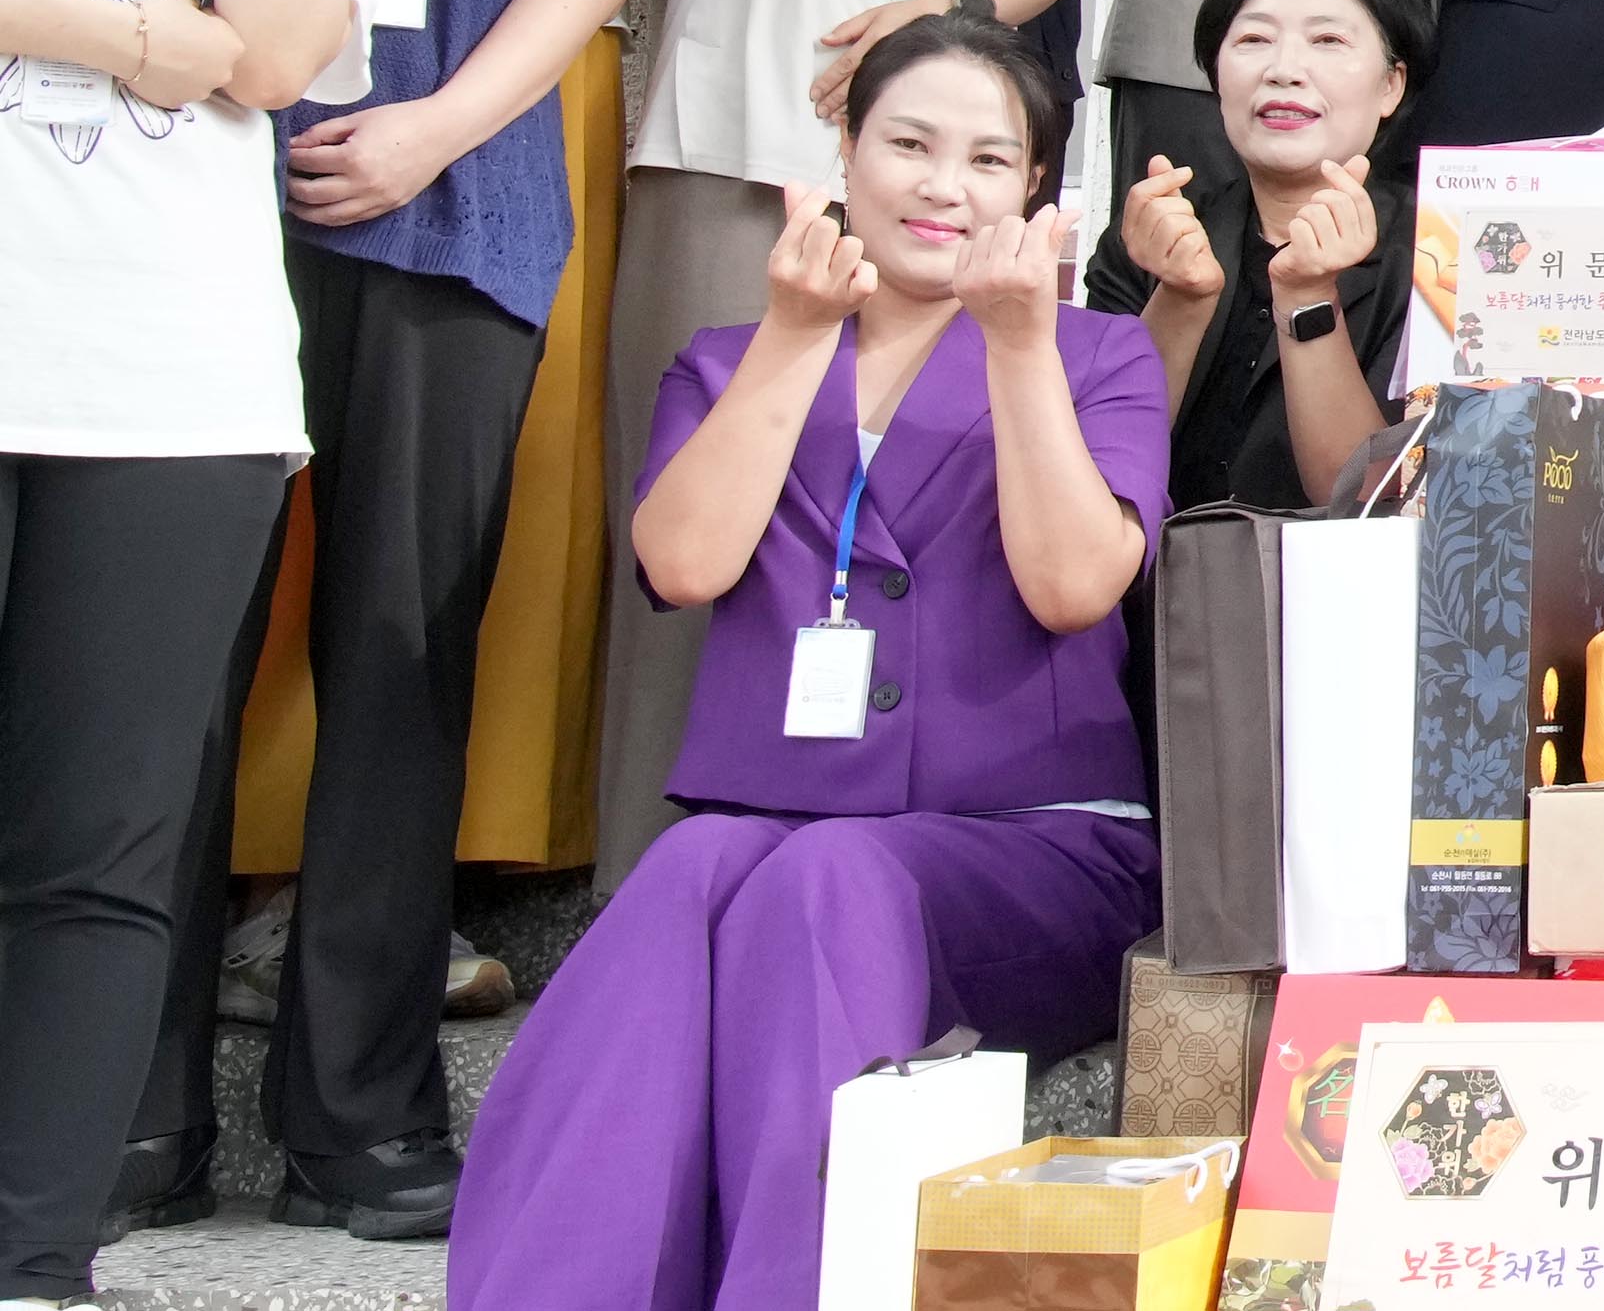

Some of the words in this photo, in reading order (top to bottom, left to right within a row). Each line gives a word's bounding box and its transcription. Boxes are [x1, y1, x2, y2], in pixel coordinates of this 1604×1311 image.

[1435, 174, 1497, 190] CROWN
[1486, 291, 1551, 311] 보름달처럼
[1555, 293, 1594, 310] 풍성한
[1438, 1089, 1472, 1181] 한가위
[1399, 1240, 1567, 1291] 보름달처럼
